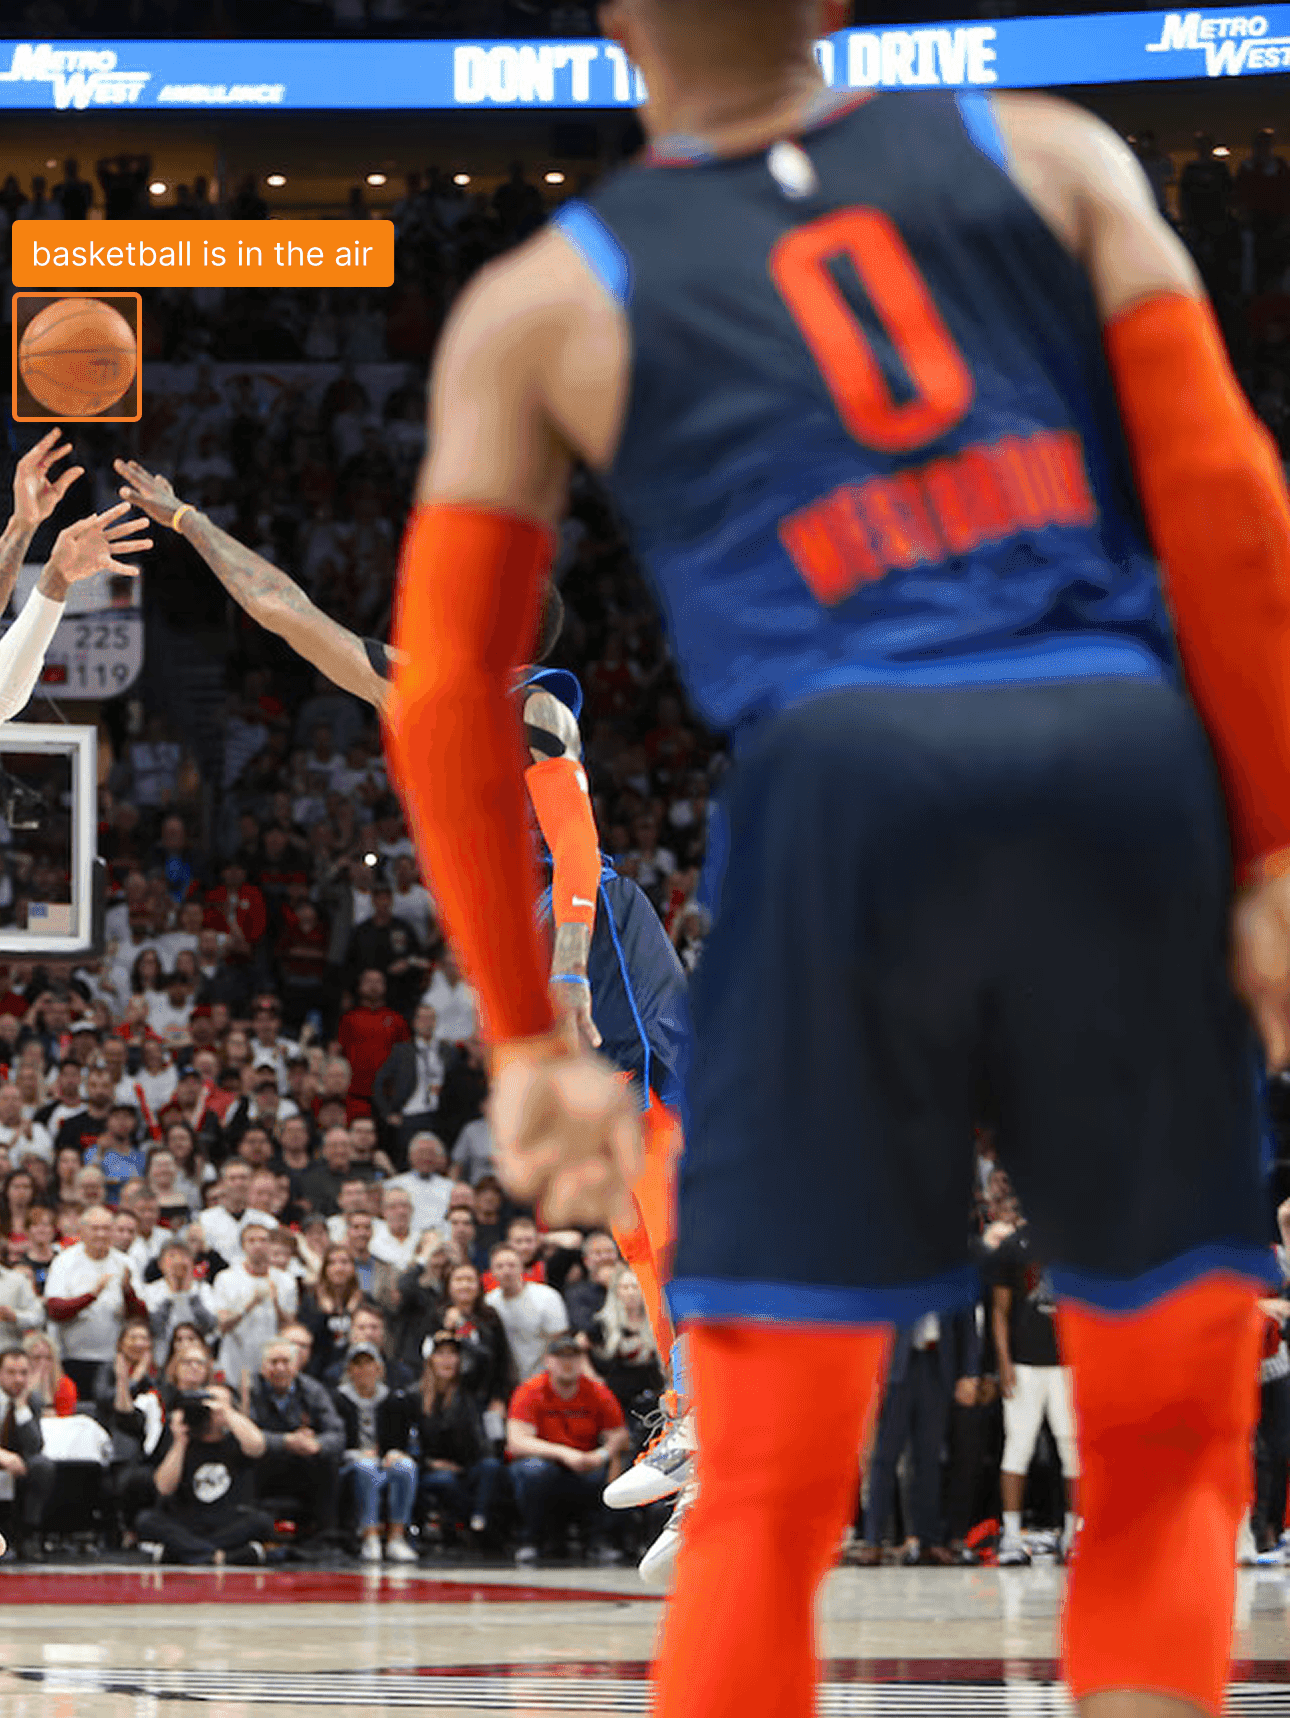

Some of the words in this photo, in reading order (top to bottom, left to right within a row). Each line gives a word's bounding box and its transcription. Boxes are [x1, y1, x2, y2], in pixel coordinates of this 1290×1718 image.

[454, 45, 599, 103] DON'T
[848, 26, 998, 87] DRIVE
[769, 204, 975, 454] 0
[76, 624, 130, 650] 225
[76, 663, 130, 687] 119
